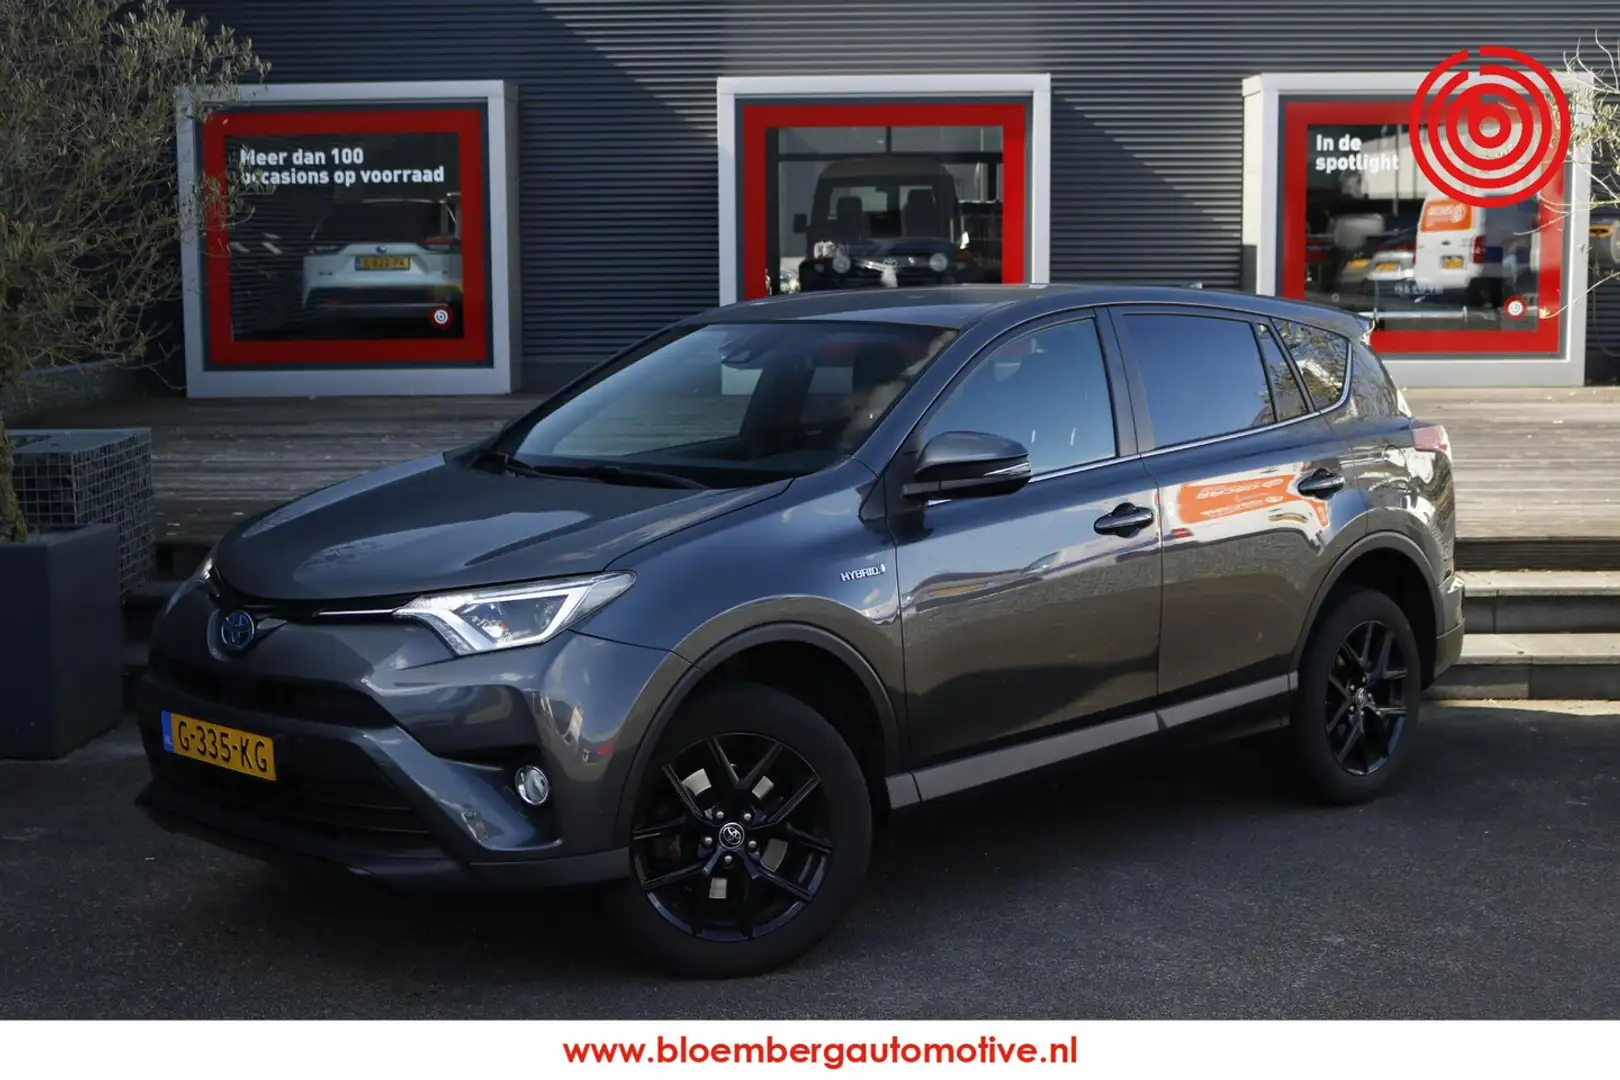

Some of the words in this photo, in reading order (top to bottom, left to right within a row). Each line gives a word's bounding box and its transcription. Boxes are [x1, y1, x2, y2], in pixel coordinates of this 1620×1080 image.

[1316, 134, 1334, 151] In
[1339, 134, 1361, 151] de
[240, 149, 287, 165] Meer
[292, 148, 326, 165] dan
[331, 147, 364, 164] 100
[1315, 153, 1399, 174] spotlight
[333, 170, 356, 187] op
[360, 165, 444, 183] voorraad
[840, 565, 880, 582] HYBRID
[178, 720, 268, 773] G-335-KG
